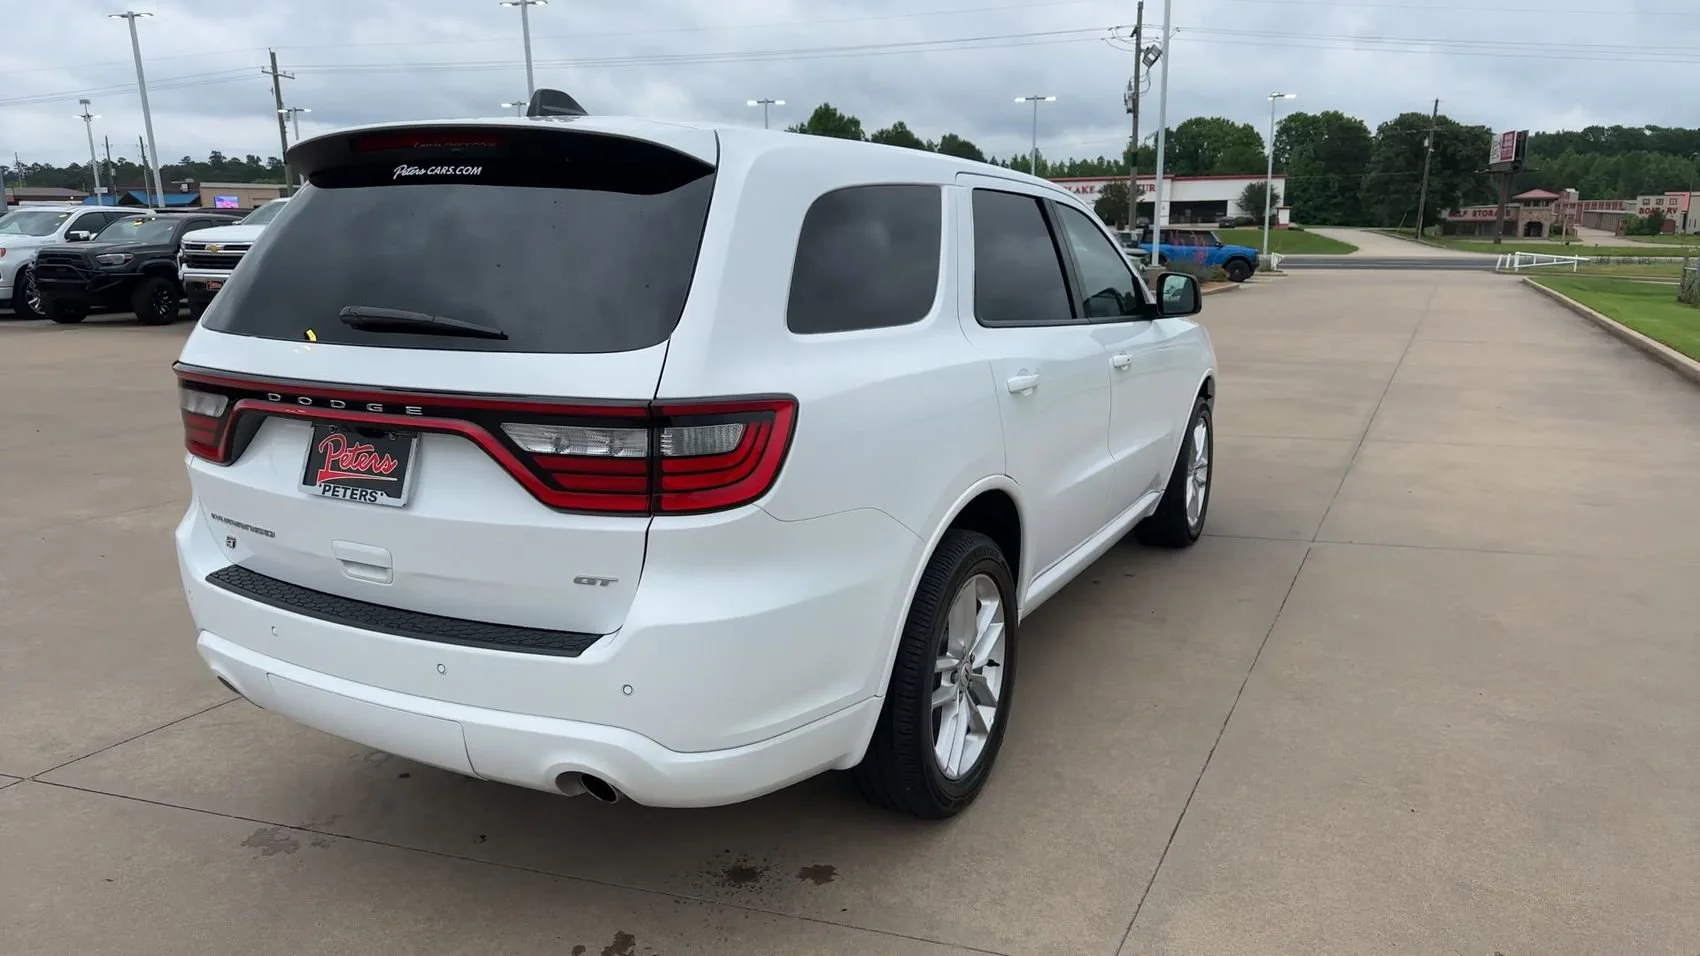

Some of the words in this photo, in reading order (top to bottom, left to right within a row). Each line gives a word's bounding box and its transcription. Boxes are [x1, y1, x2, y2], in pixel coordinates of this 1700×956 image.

[393, 164, 426, 180] Peters
[427, 166, 483, 175] CARS.COM
[267, 392, 423, 416] DODGE
[318, 433, 399, 474] Peters
[321, 484, 379, 503] PETERS
[573, 576, 619, 587] GT
